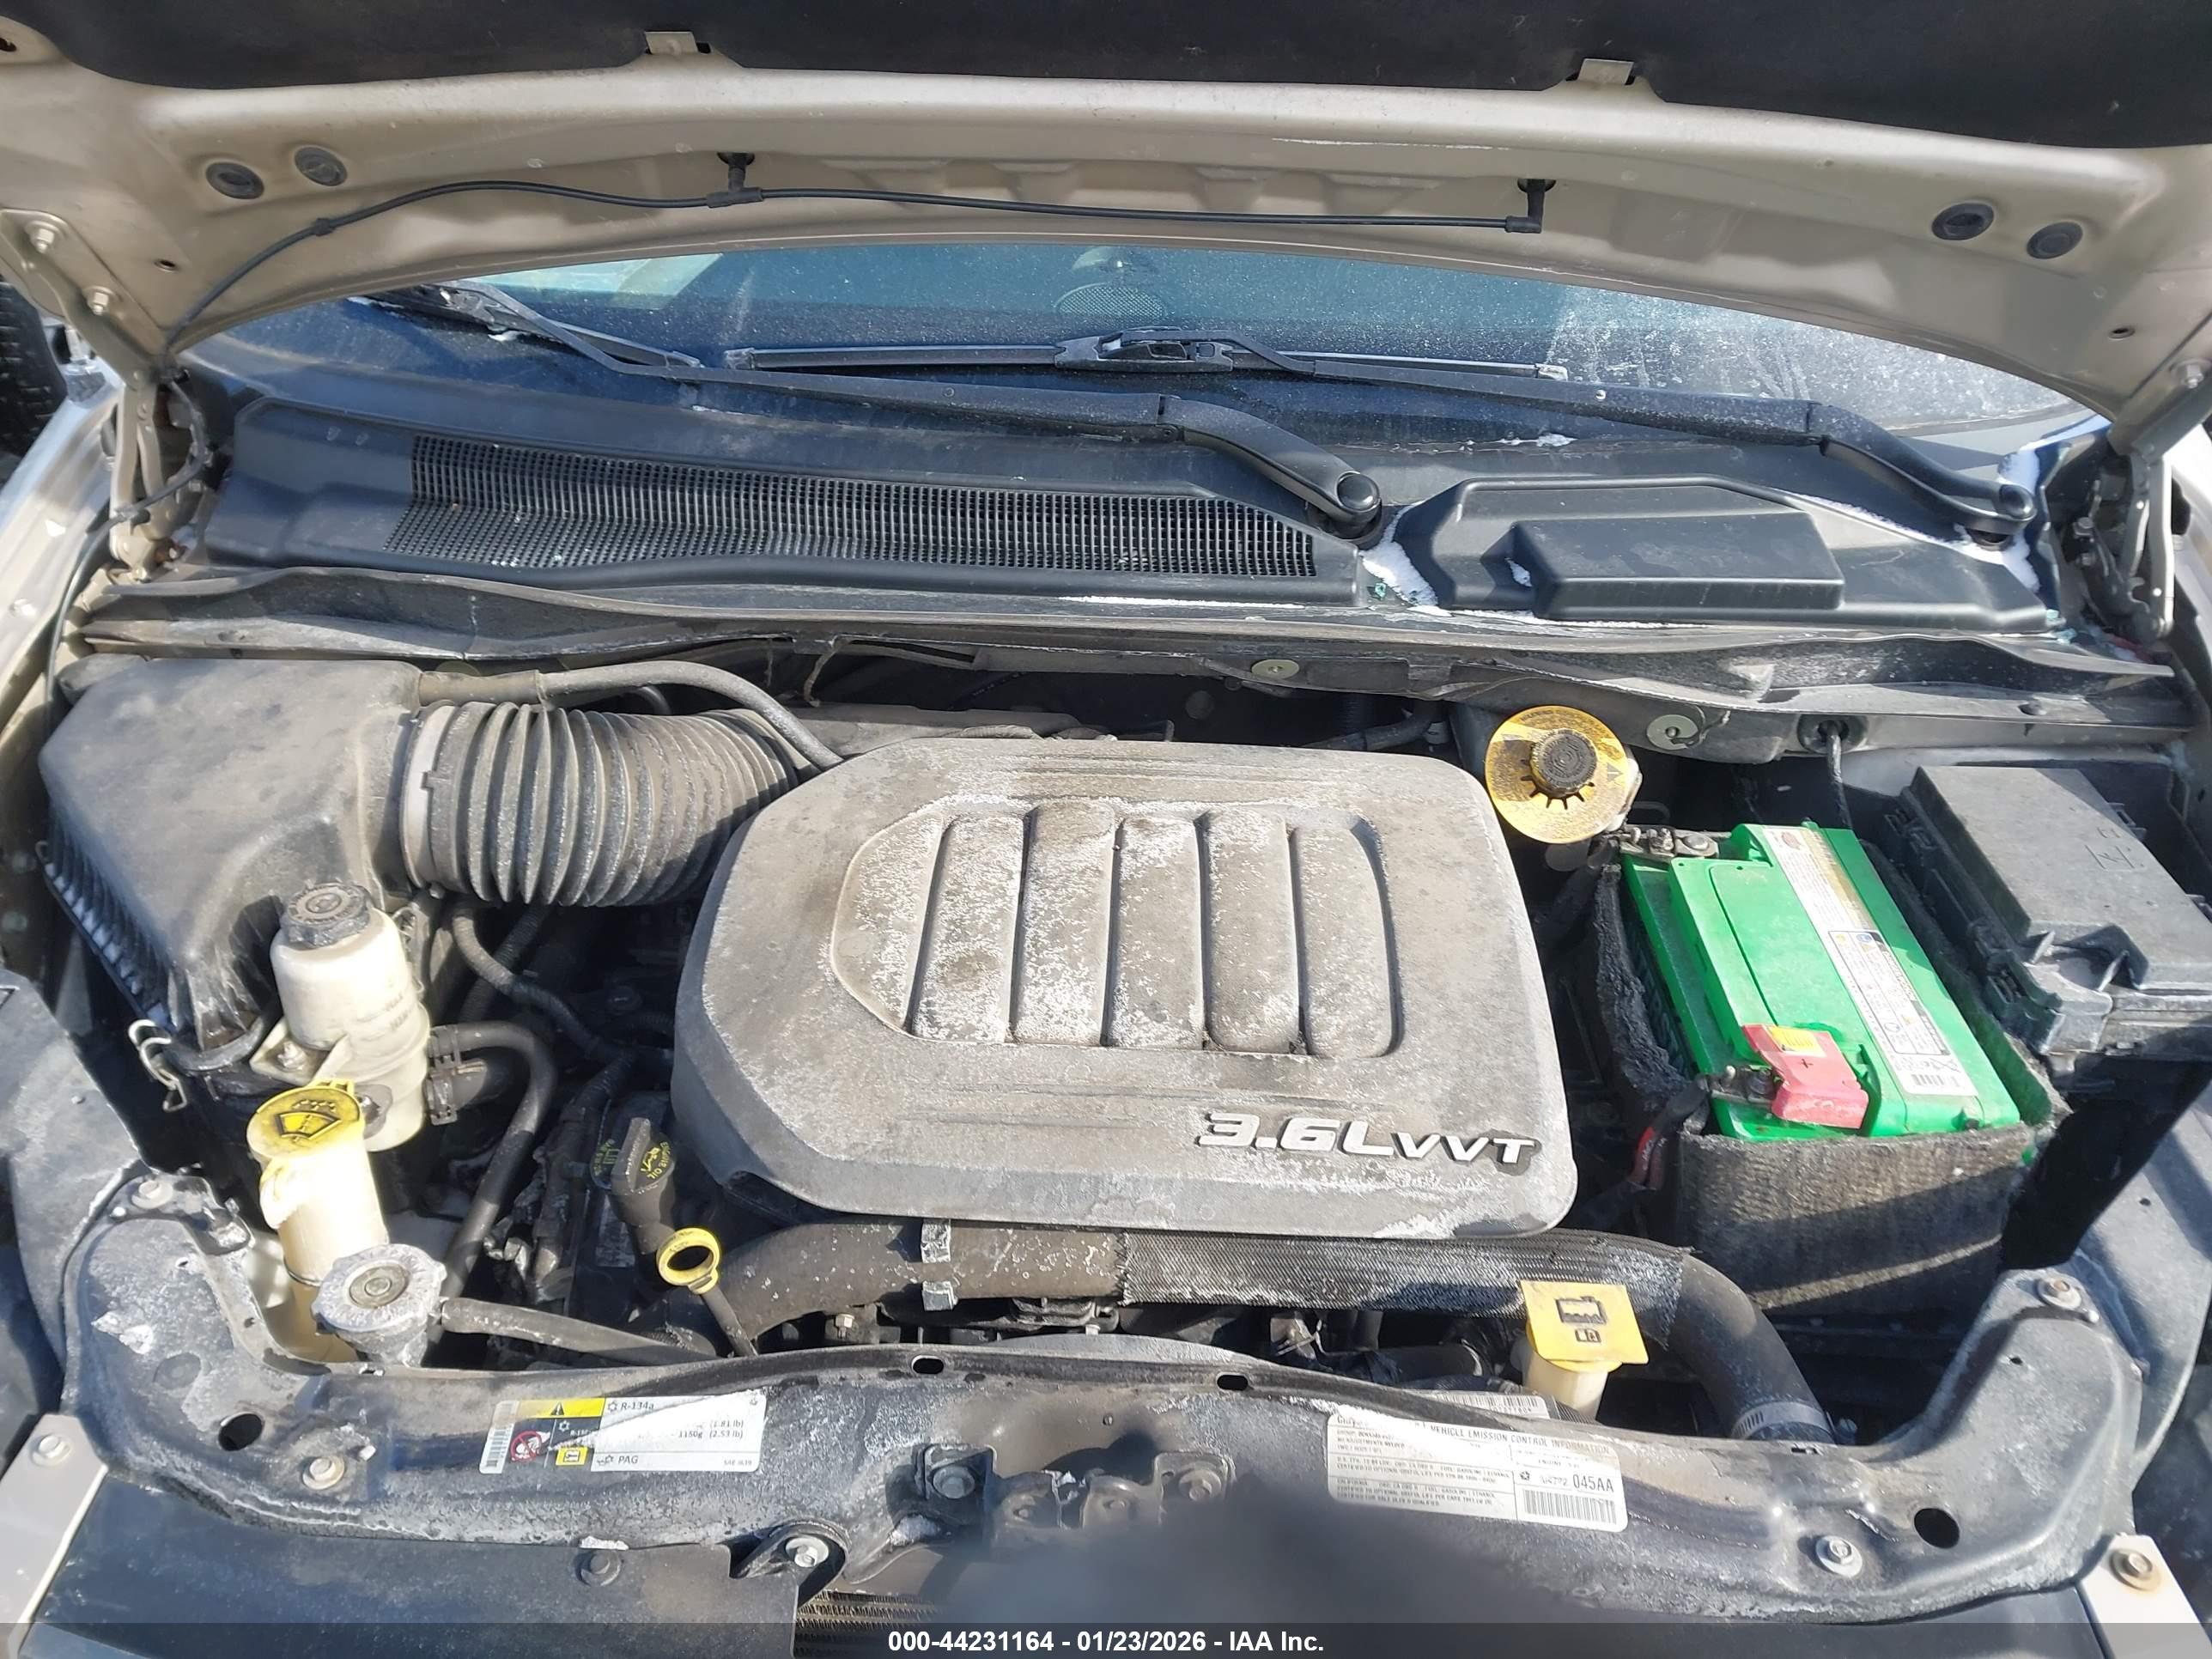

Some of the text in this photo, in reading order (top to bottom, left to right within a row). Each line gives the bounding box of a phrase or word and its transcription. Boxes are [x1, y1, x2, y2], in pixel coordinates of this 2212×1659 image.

[647, 1167, 662, 1180] OIL
[621, 1401, 654, 1411] R-134a
[1468, 1429, 1509, 1443] EMISSION
[1510, 1434, 1548, 1448] CONTROL
[618, 1455, 639, 1464] PAG
[1572, 1474, 1614, 1493] 045AA
